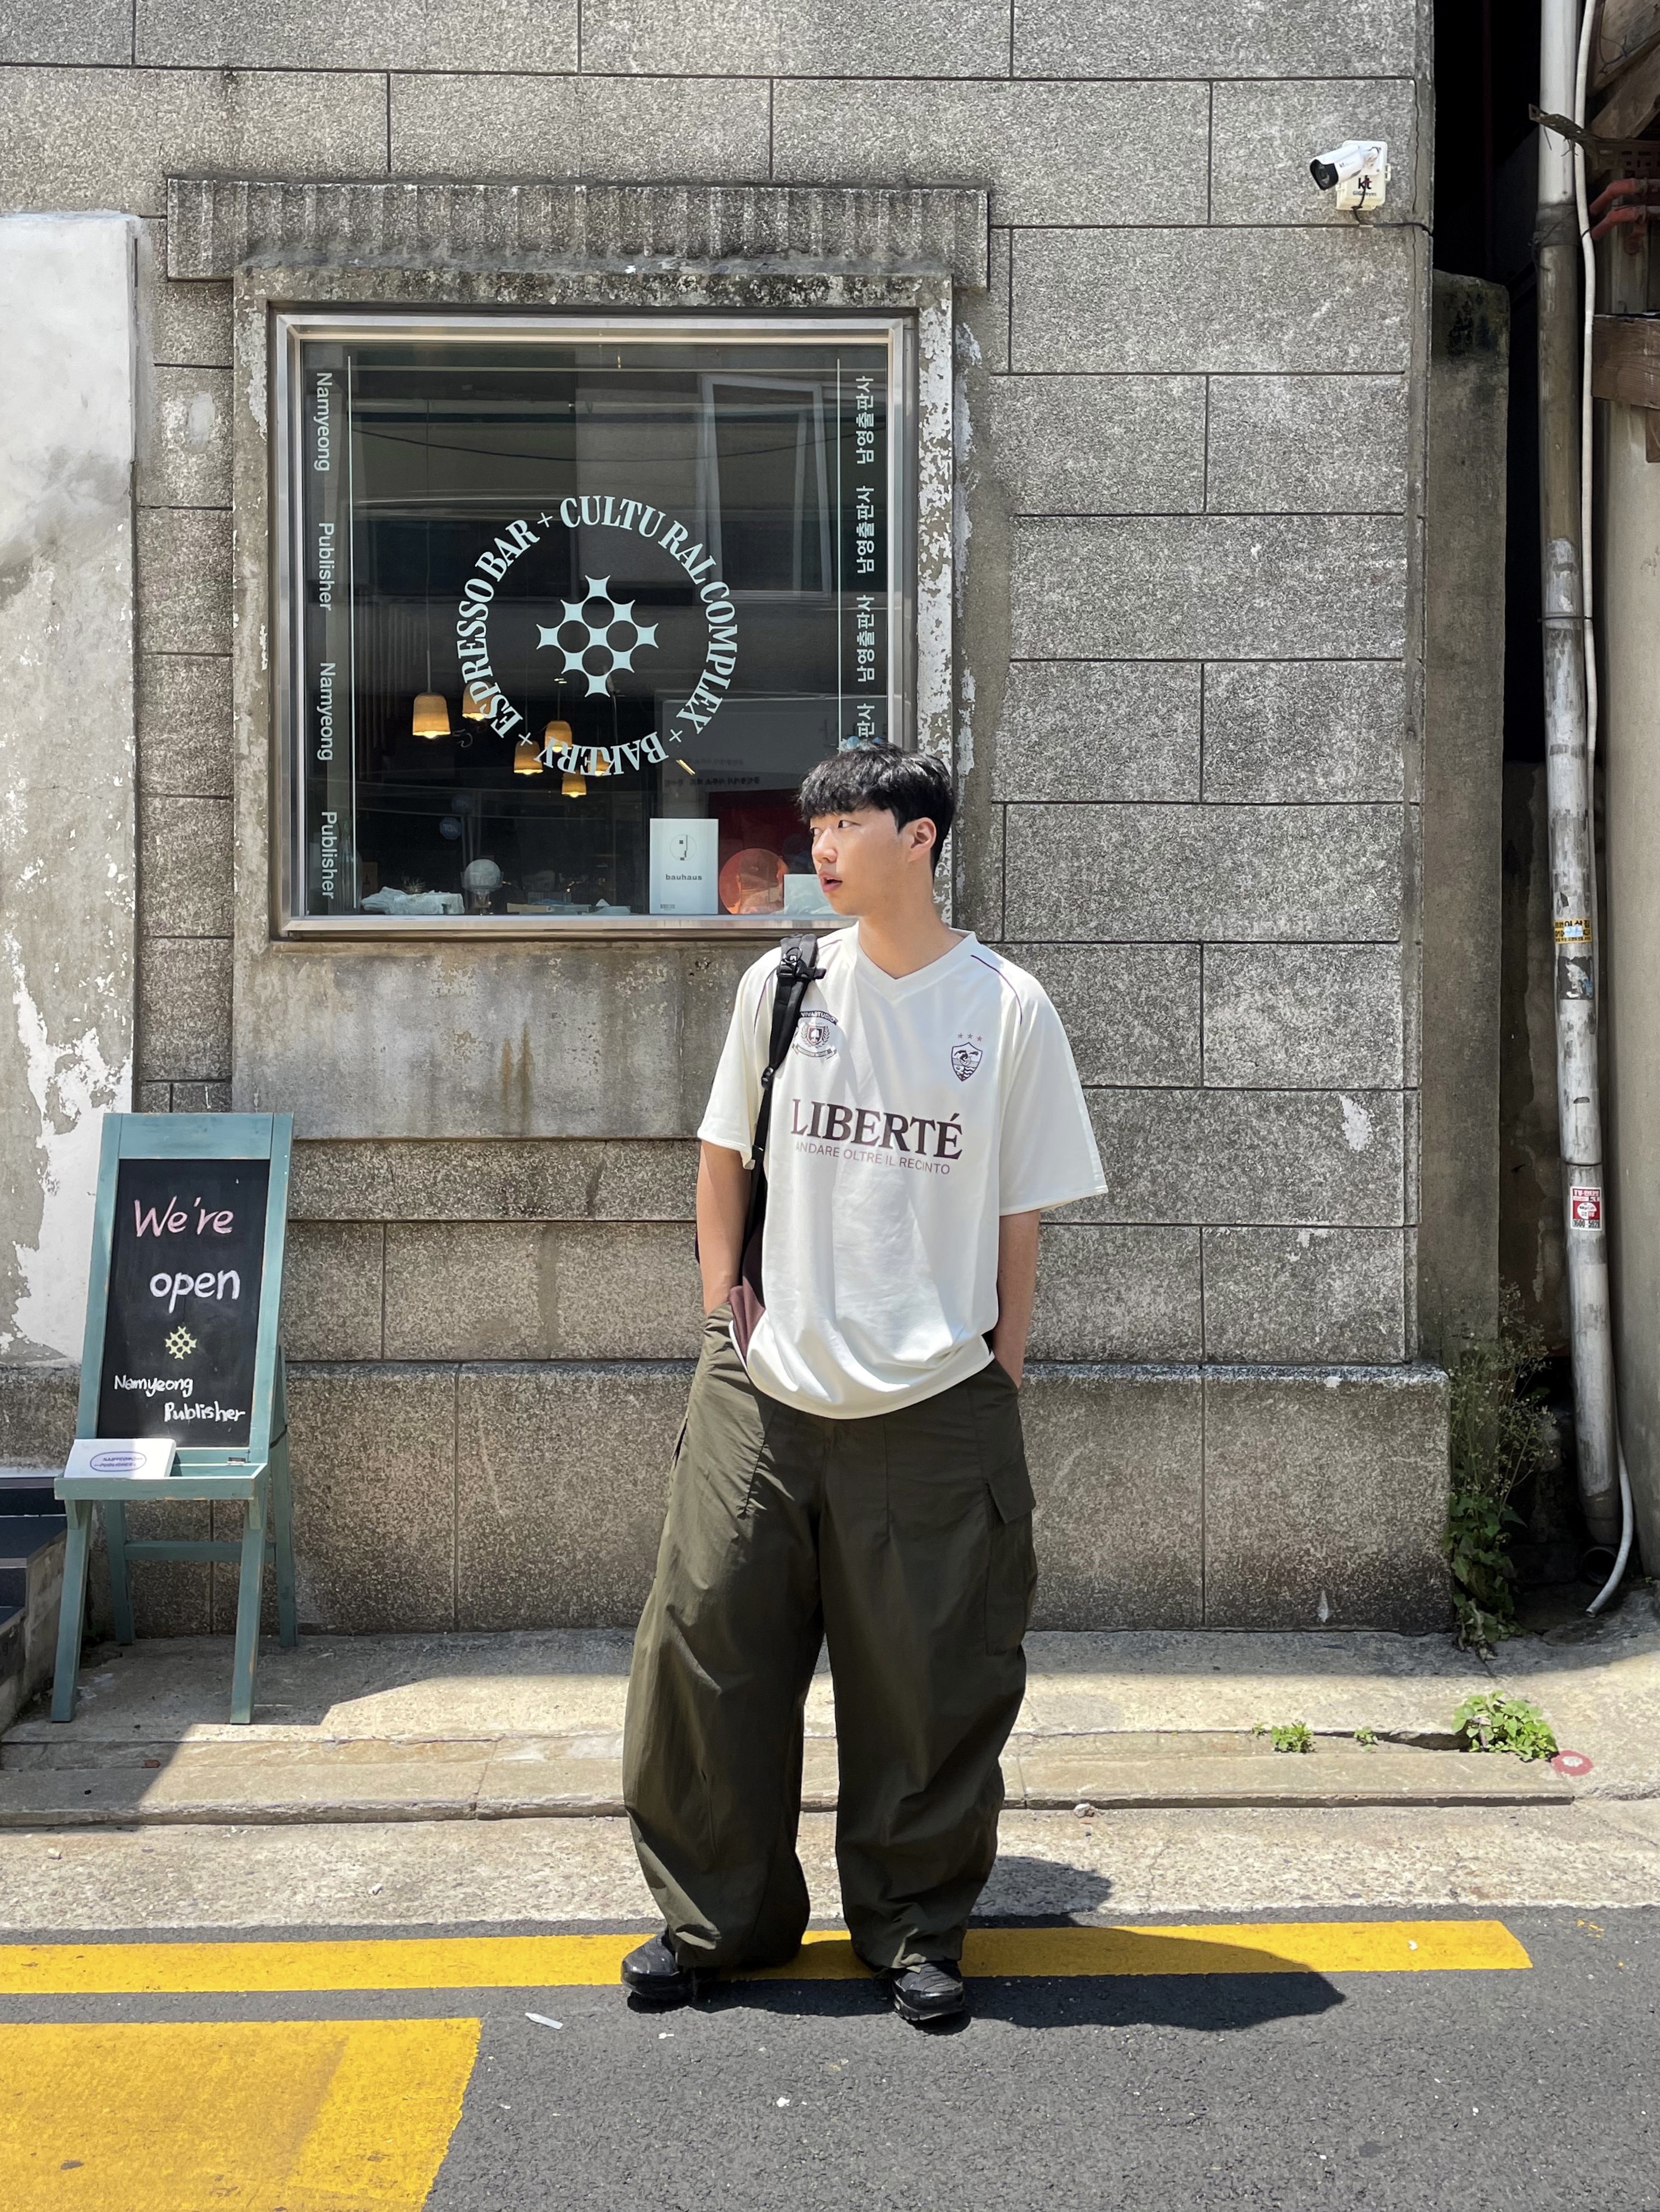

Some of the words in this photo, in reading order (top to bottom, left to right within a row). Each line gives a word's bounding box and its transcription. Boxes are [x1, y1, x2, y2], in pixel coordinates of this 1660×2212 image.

[313, 372, 332, 472] Namyeong
[856, 376, 874, 464] 남영출판사
[319, 523, 335, 611] Publisher
[475, 519, 541, 582] BAR
[856, 485, 874, 573] 남영출판사
[457, 578, 523, 738] ESPRESSO
[676, 581, 738, 735] COMPLEX
[857, 595, 875, 682] 남영출판사
[317, 663, 336, 761] Namyeong
[534, 732, 669, 776] BAKERY
[321, 812, 337, 899] Publisher
[790, 1099, 963, 1160] LIBERTÉ
[796, 1141, 840, 1157] ANDARE
[843, 1149, 883, 1164] OLTRE
[885, 1156, 896, 1166] IL
[899, 1157, 950, 1175] RECINTO
[134, 1196, 234, 1237] We're
[149, 1269, 241, 1314] open
[115, 1375, 193, 1397] Namyeong
[164, 1401, 246, 1422] Publisher
